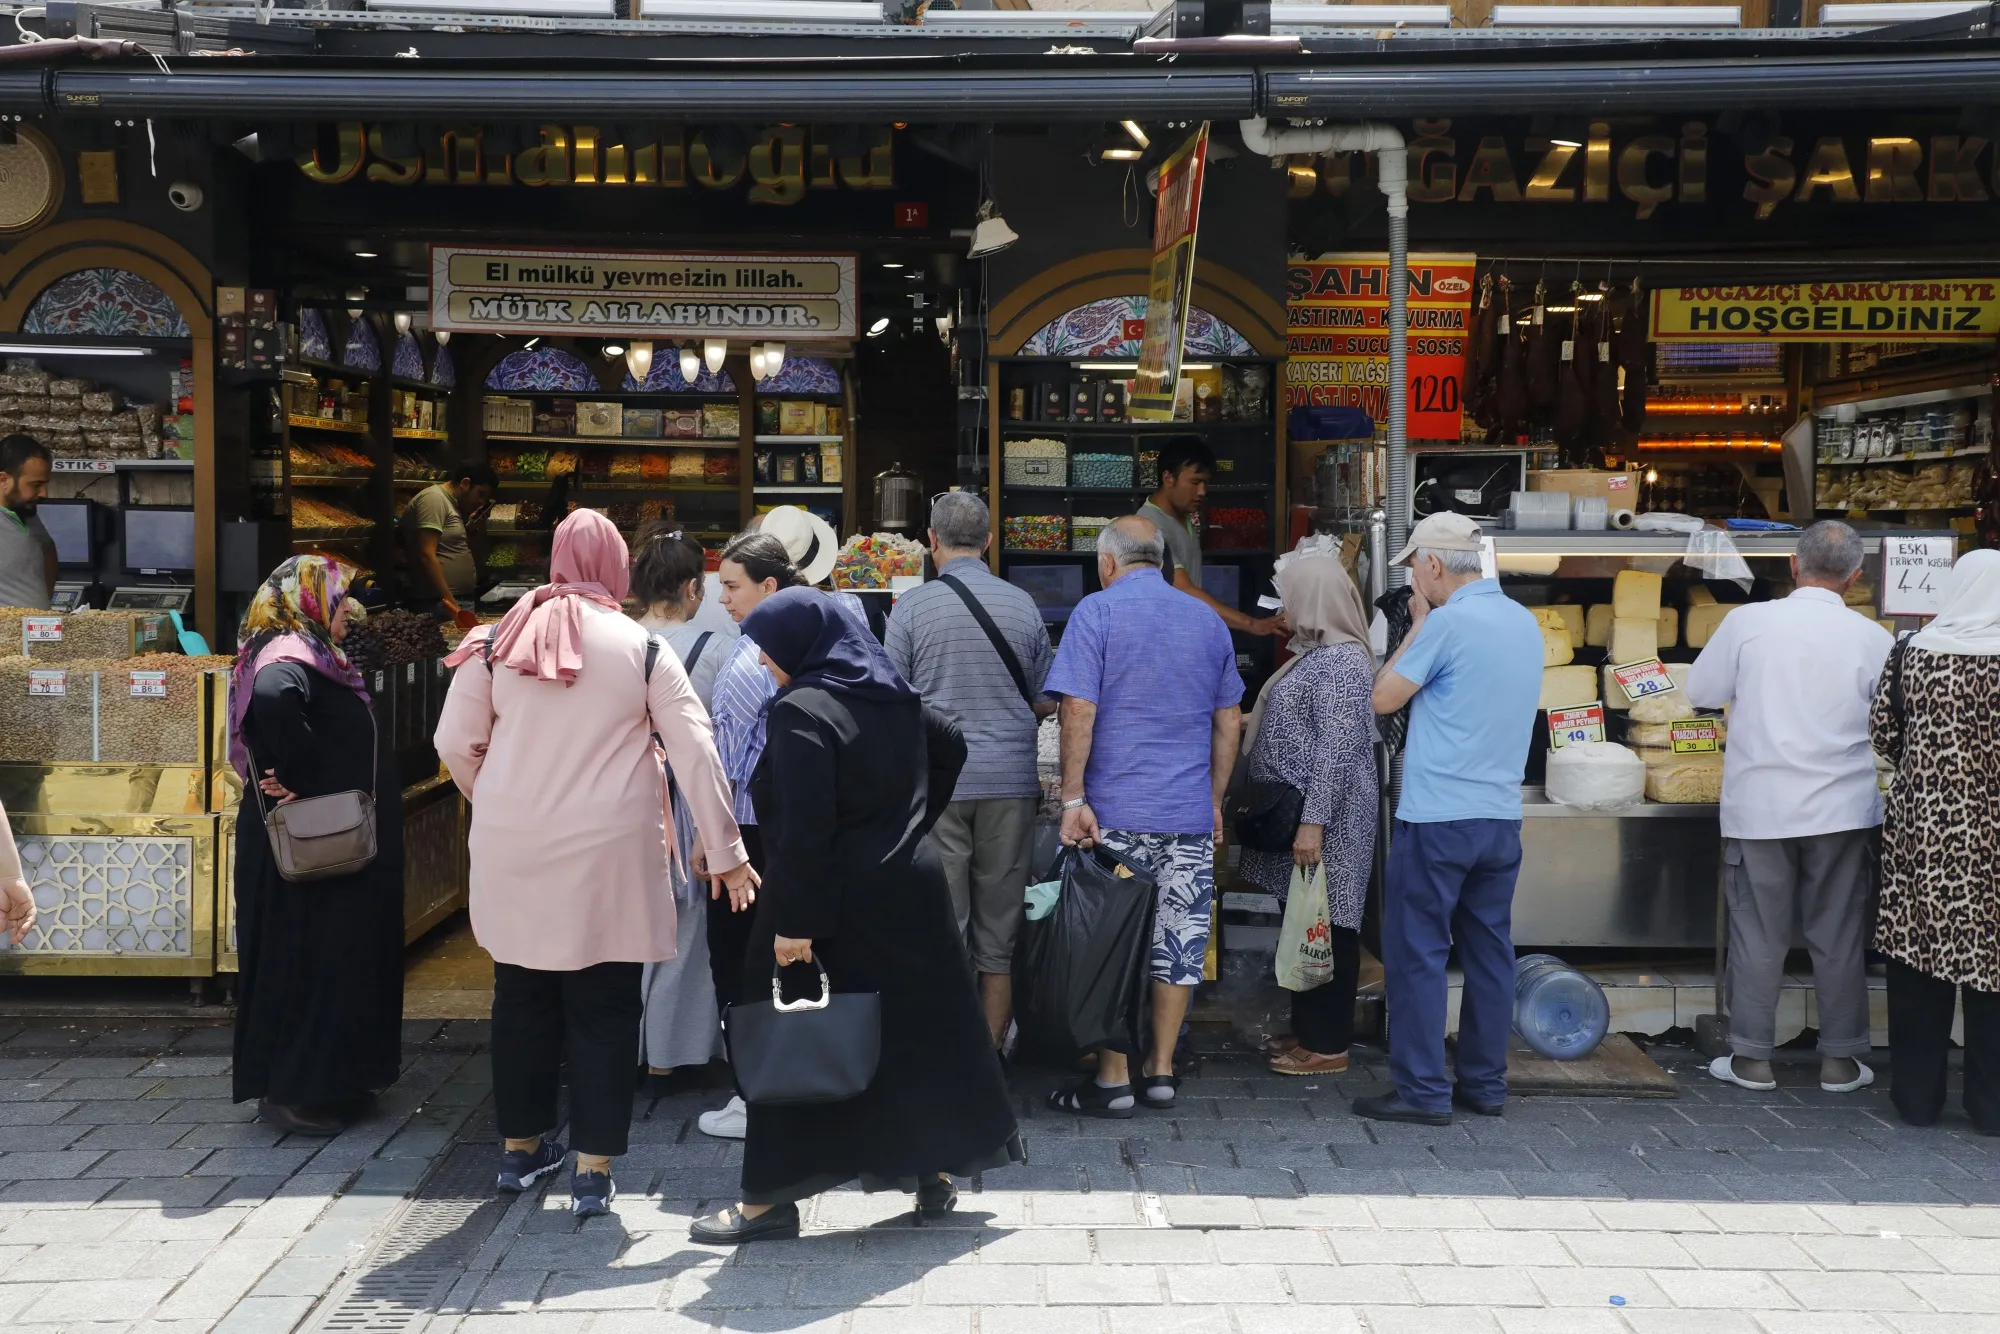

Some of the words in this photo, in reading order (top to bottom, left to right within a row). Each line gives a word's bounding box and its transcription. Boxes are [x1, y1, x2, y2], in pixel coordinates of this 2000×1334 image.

[1742, 133, 2000, 220] ŞARK
[486, 262, 509, 282] El
[518, 264, 594, 285] mülkü
[603, 267, 727, 290] yevmeizin
[735, 268, 803, 288] lillah.
[1286, 267, 1433, 302] ŞAHN
[1438, 278, 1466, 292] ÖZEL
[469, 293, 575, 323] MÜLK
[578, 300, 820, 328] ALLAH'INDIR.
[1286, 307, 1366, 328] ASTIRMA
[1380, 309, 1464, 329] KVURMA
[1286, 337, 1333, 353] ALAM
[1410, 375, 1459, 413] 120
[41, 684, 51, 693] 70
[141, 685, 152, 693] 86
[1636, 680, 1659, 695] 28
[1567, 729, 1585, 742] 19
[1686, 742, 1697, 750] 30
